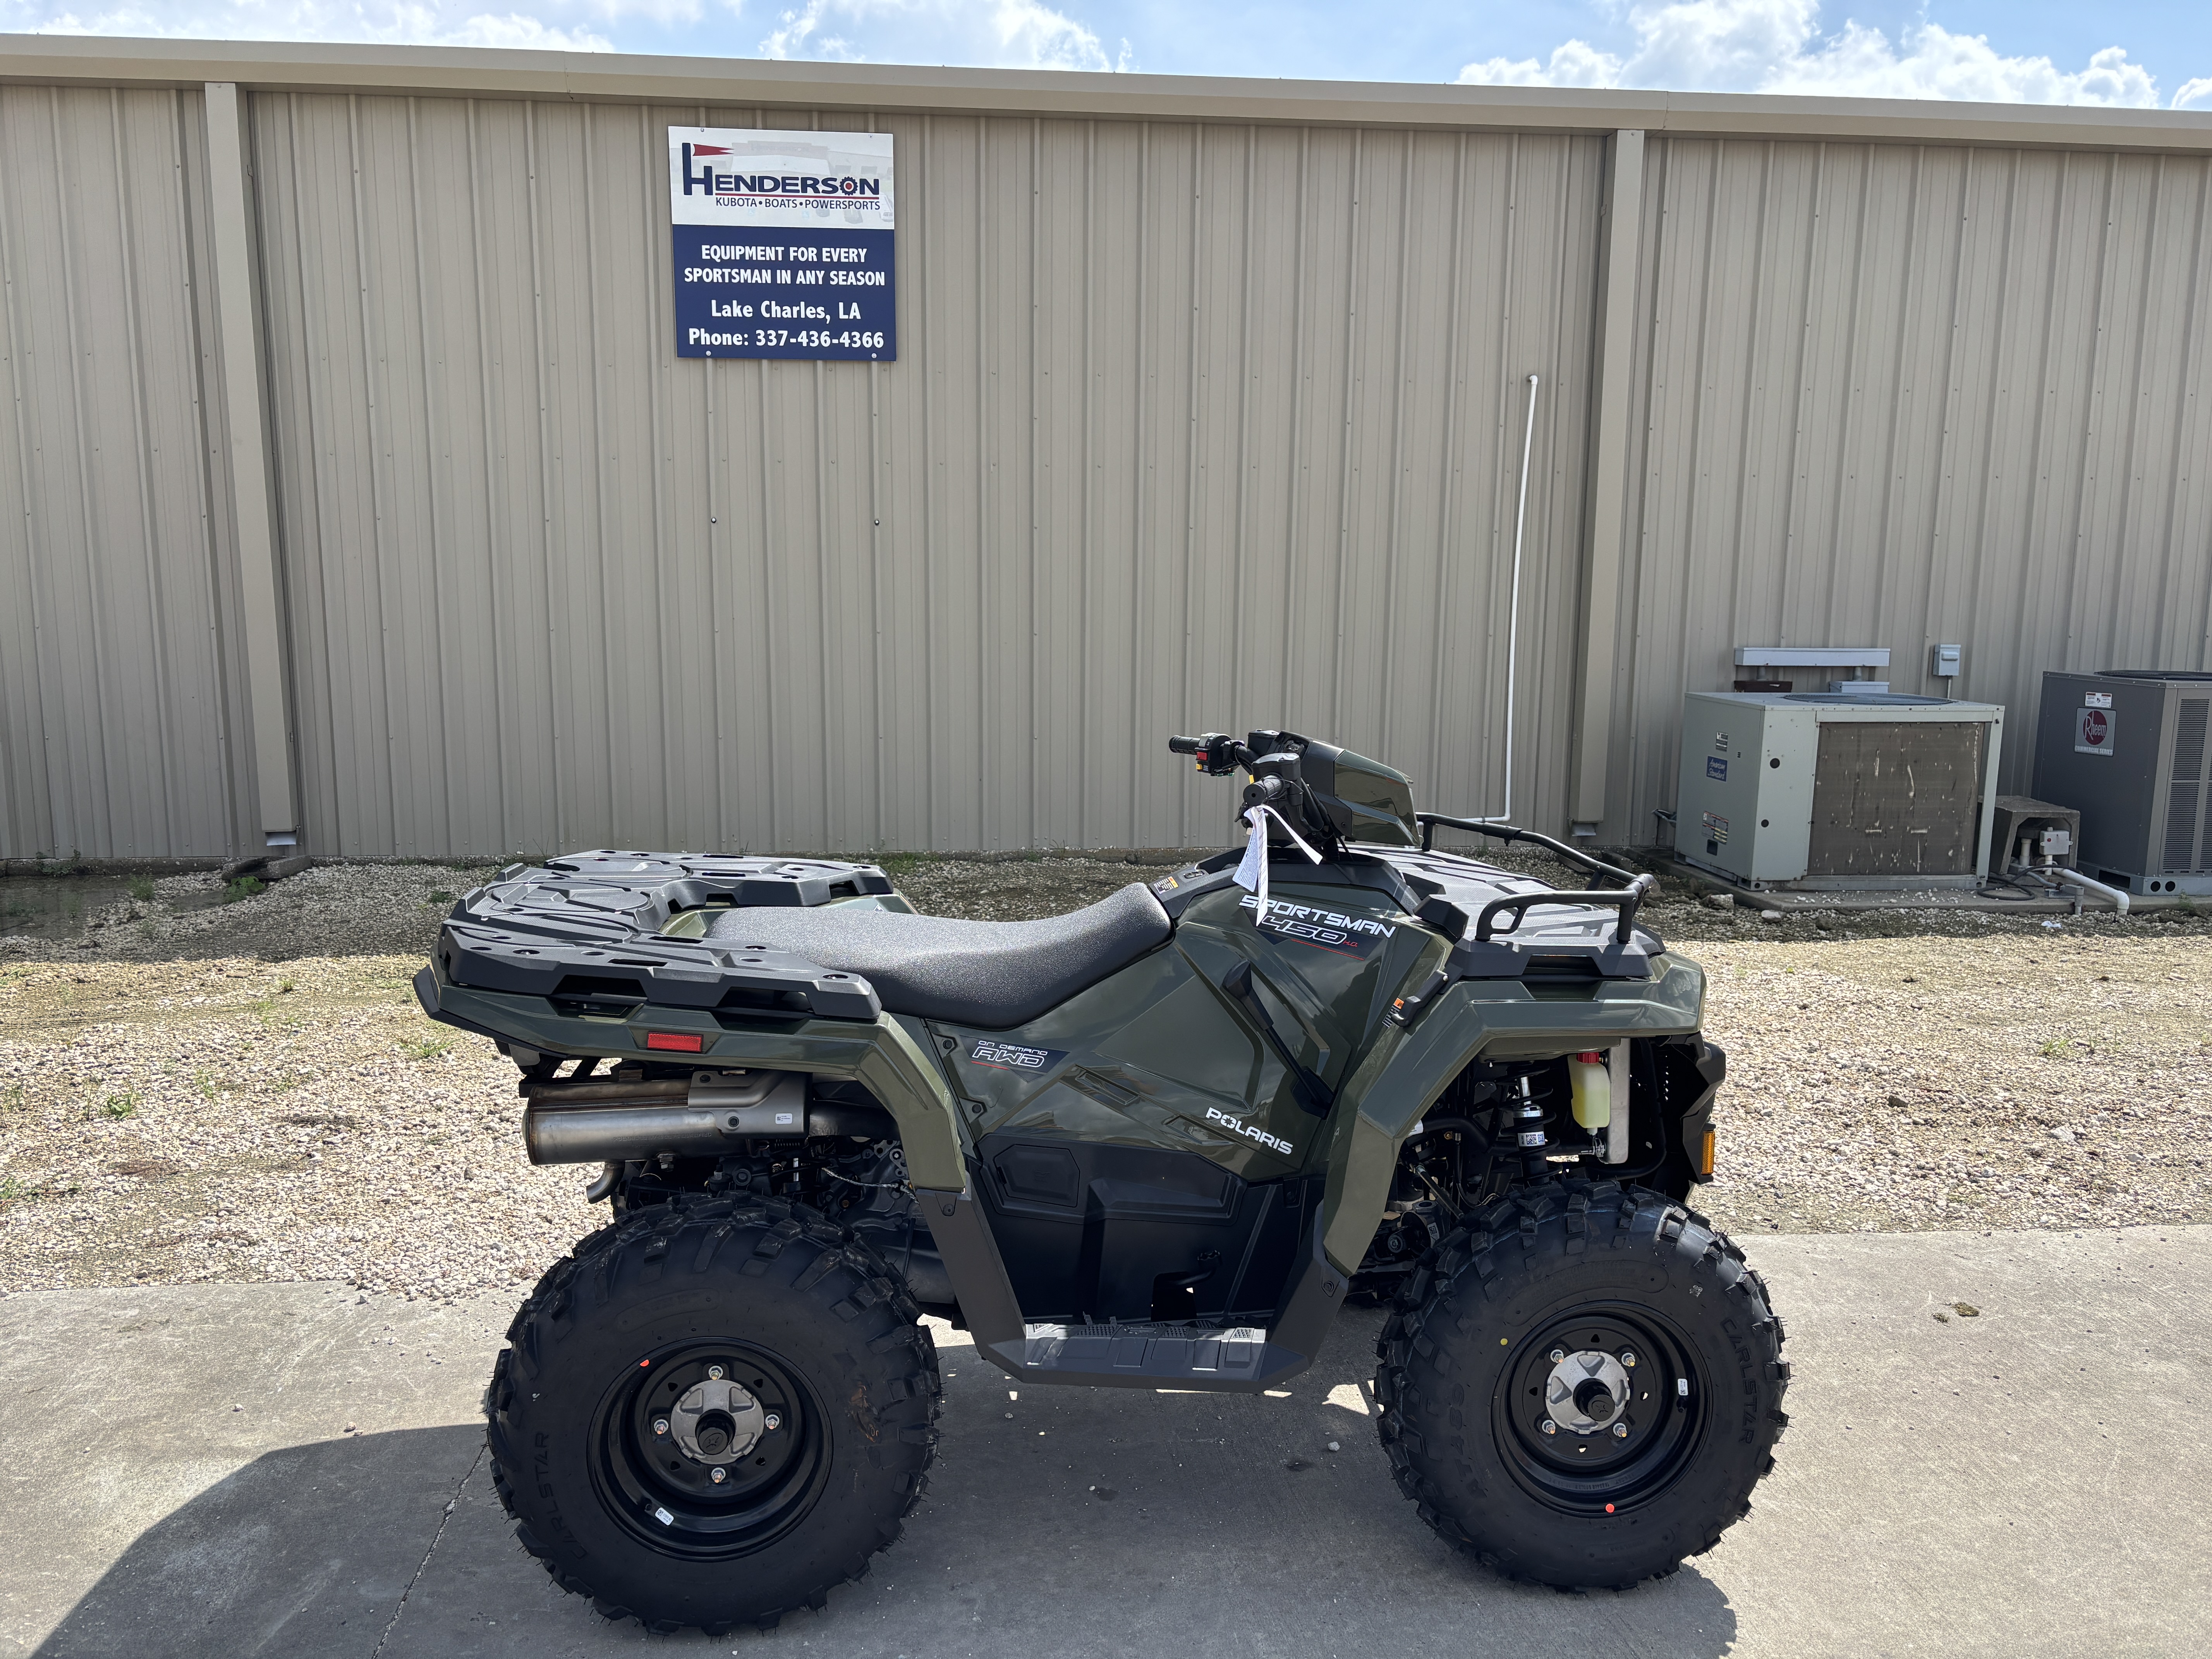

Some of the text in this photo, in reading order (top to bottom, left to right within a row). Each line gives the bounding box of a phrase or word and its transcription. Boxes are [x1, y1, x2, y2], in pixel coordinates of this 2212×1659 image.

[682, 142, 879, 196] HENDERSON
[715, 197, 880, 210] KUBOTA BOATS POWERSPORTS
[702, 245, 867, 263] EQUIPMENT FOR EVERY
[684, 268, 885, 286] SPORTSMAN IN ANY SEASON
[711, 300, 861, 324] Lake Charles, LA
[689, 328, 884, 348] Phone: 337-436-4366
[2084, 711, 2106, 740] Rheem
[2075, 745, 2099, 754] COMMERCIAL
[1239, 895, 1396, 938] SPORTSMAN
[1261, 915, 1347, 945] 450
[972, 1046, 1045, 1068] AWD
[999, 1044, 1048, 1056] DEMAND
[1206, 1107, 1293, 1155] POLARIS
[1720, 1317, 1757, 1445] CARLSTAR
[1449, 1383, 1488, 1499] AT489
[534, 1431, 589, 1560] CARLSTAR
